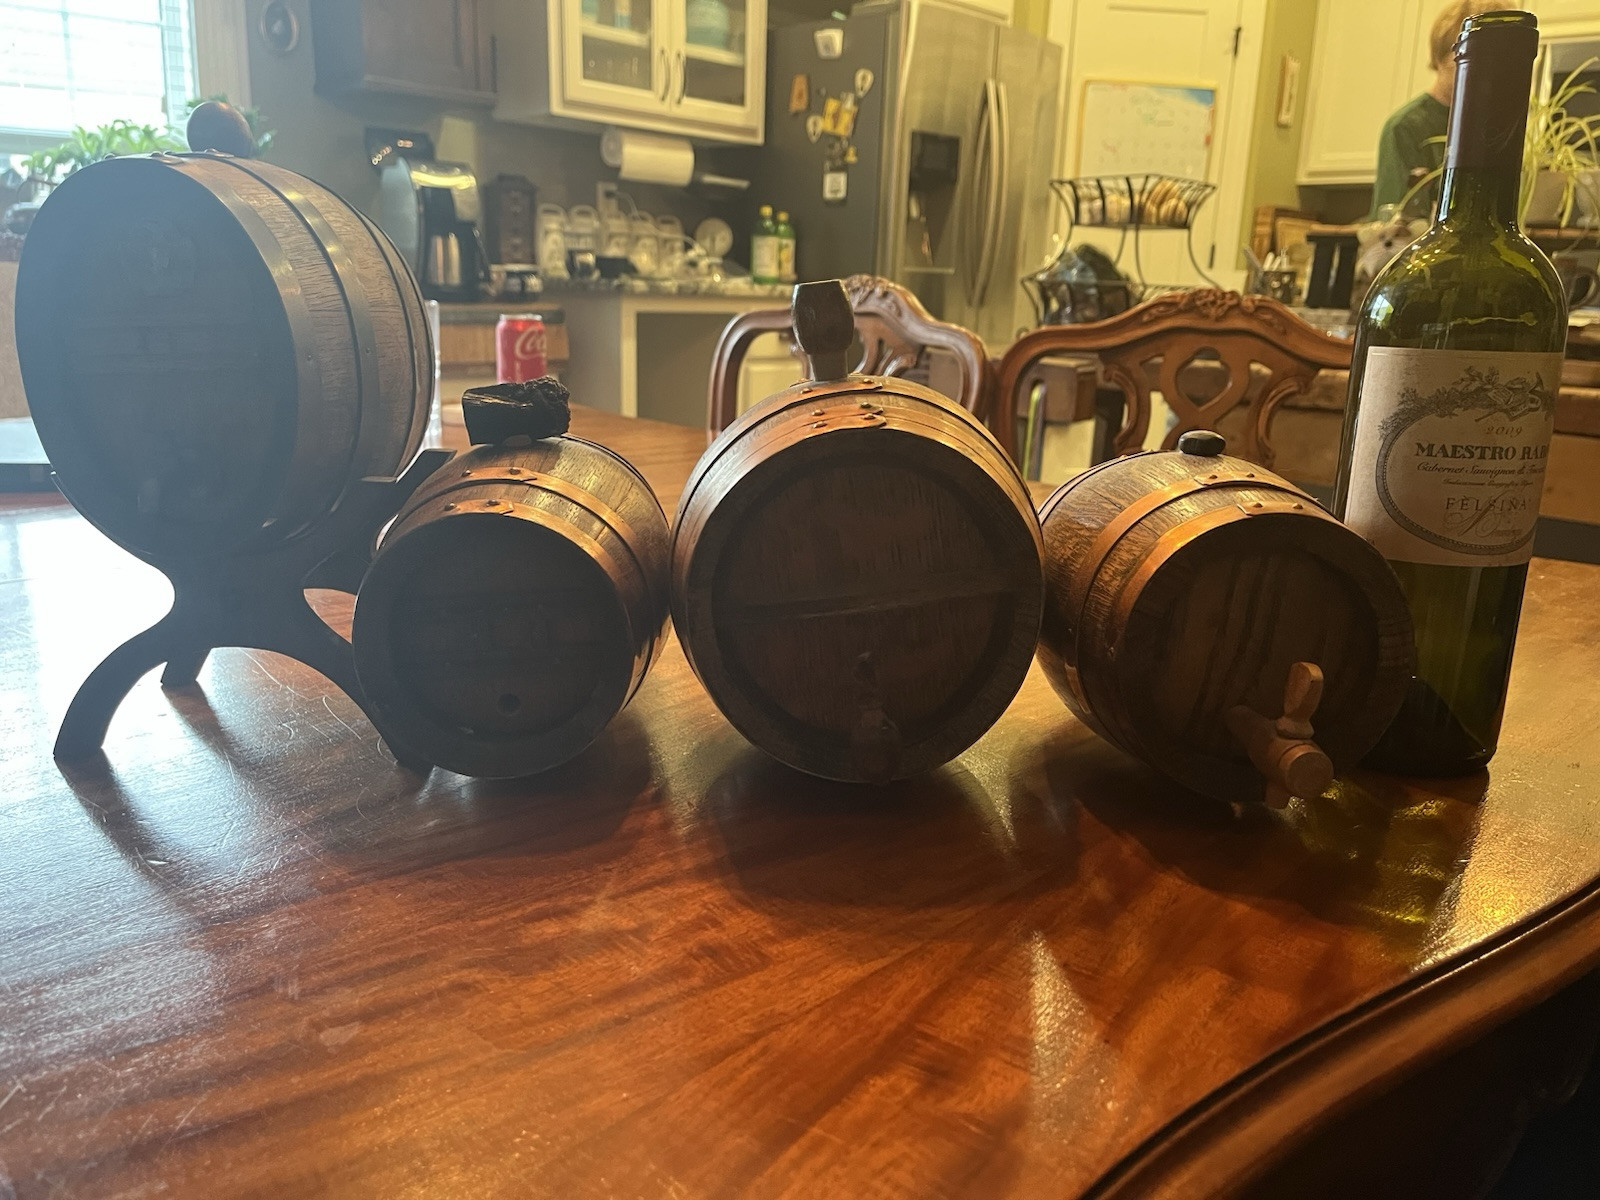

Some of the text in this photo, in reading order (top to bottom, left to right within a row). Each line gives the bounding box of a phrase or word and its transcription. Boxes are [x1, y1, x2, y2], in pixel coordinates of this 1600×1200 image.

[1485, 425, 1523, 438] 2009
[1415, 442, 1549, 460] MAESTRO RAR
[1417, 461, 1464, 474] Cabernet
[1465, 464, 1515, 479] Sauvignon
